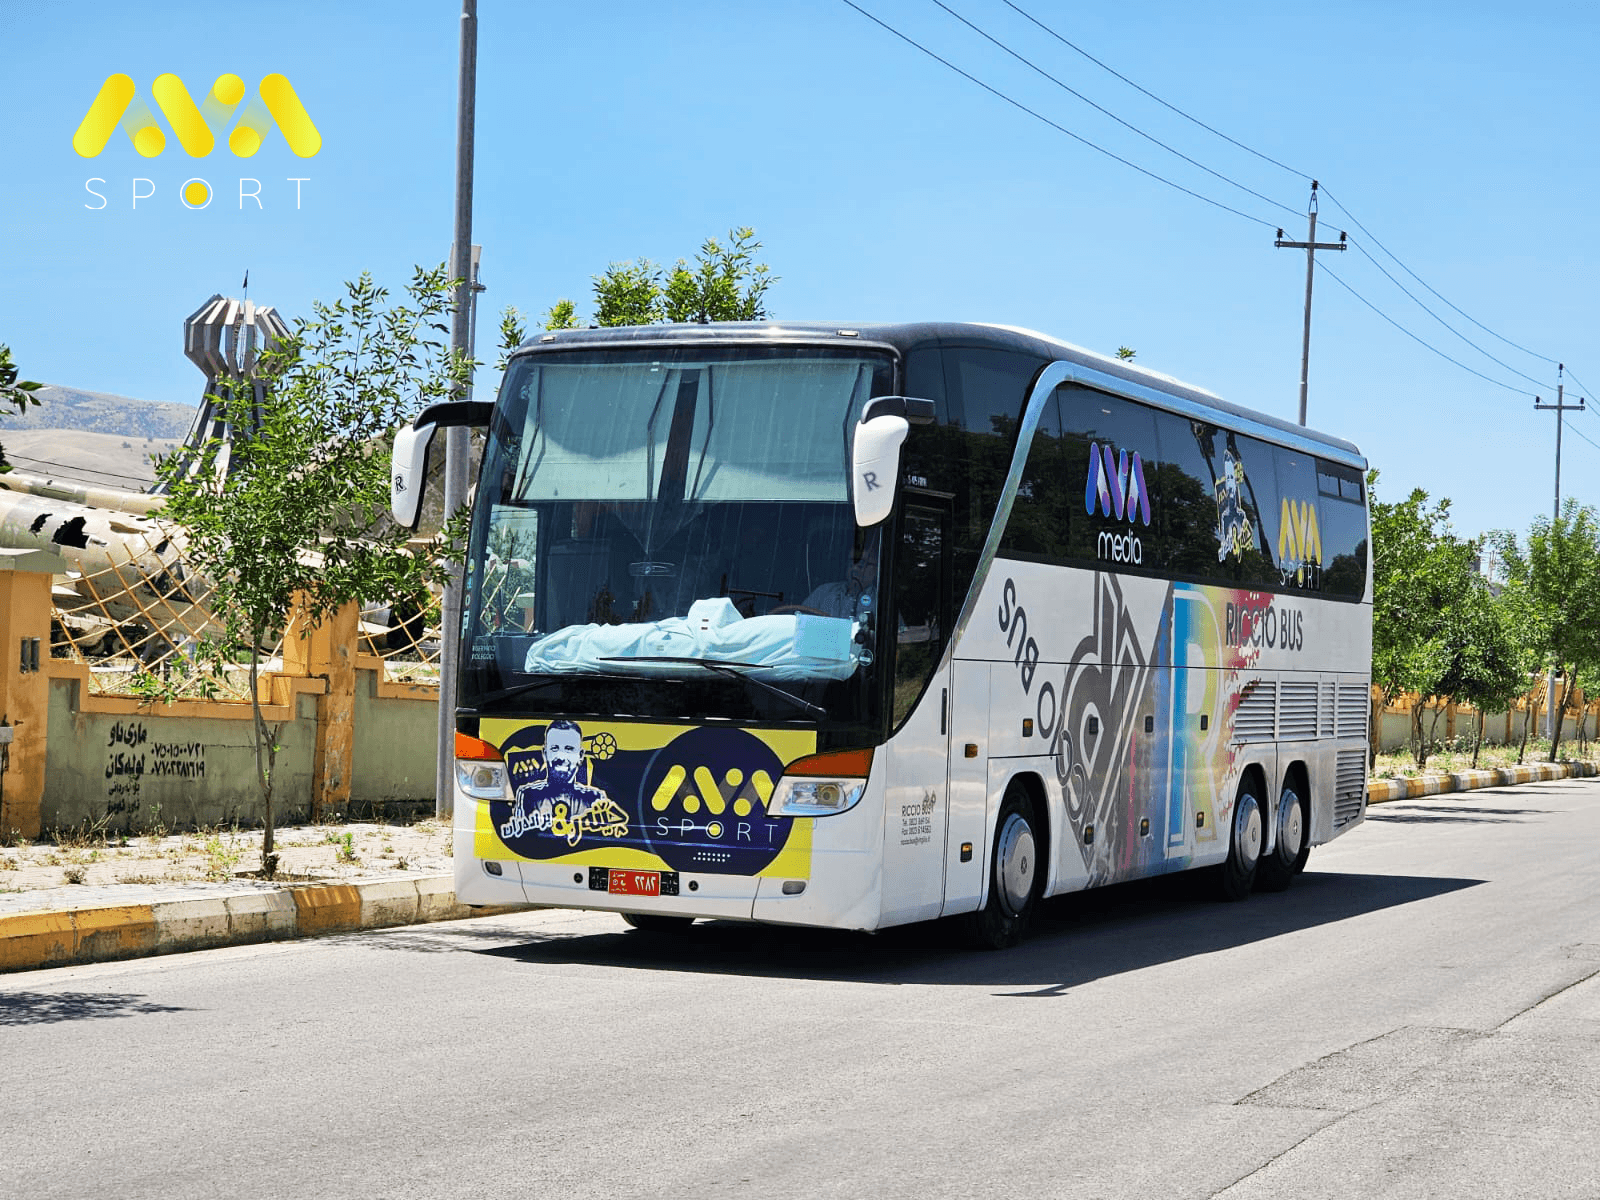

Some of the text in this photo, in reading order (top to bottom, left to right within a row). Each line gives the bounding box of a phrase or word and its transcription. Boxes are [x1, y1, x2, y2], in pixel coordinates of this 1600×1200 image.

[863, 471, 883, 492] R
[1097, 528, 1142, 565] media
[1279, 561, 1322, 590] SPORT
[1226, 601, 1303, 652] RICCIO BUS
[656, 816, 779, 843] SPORT
